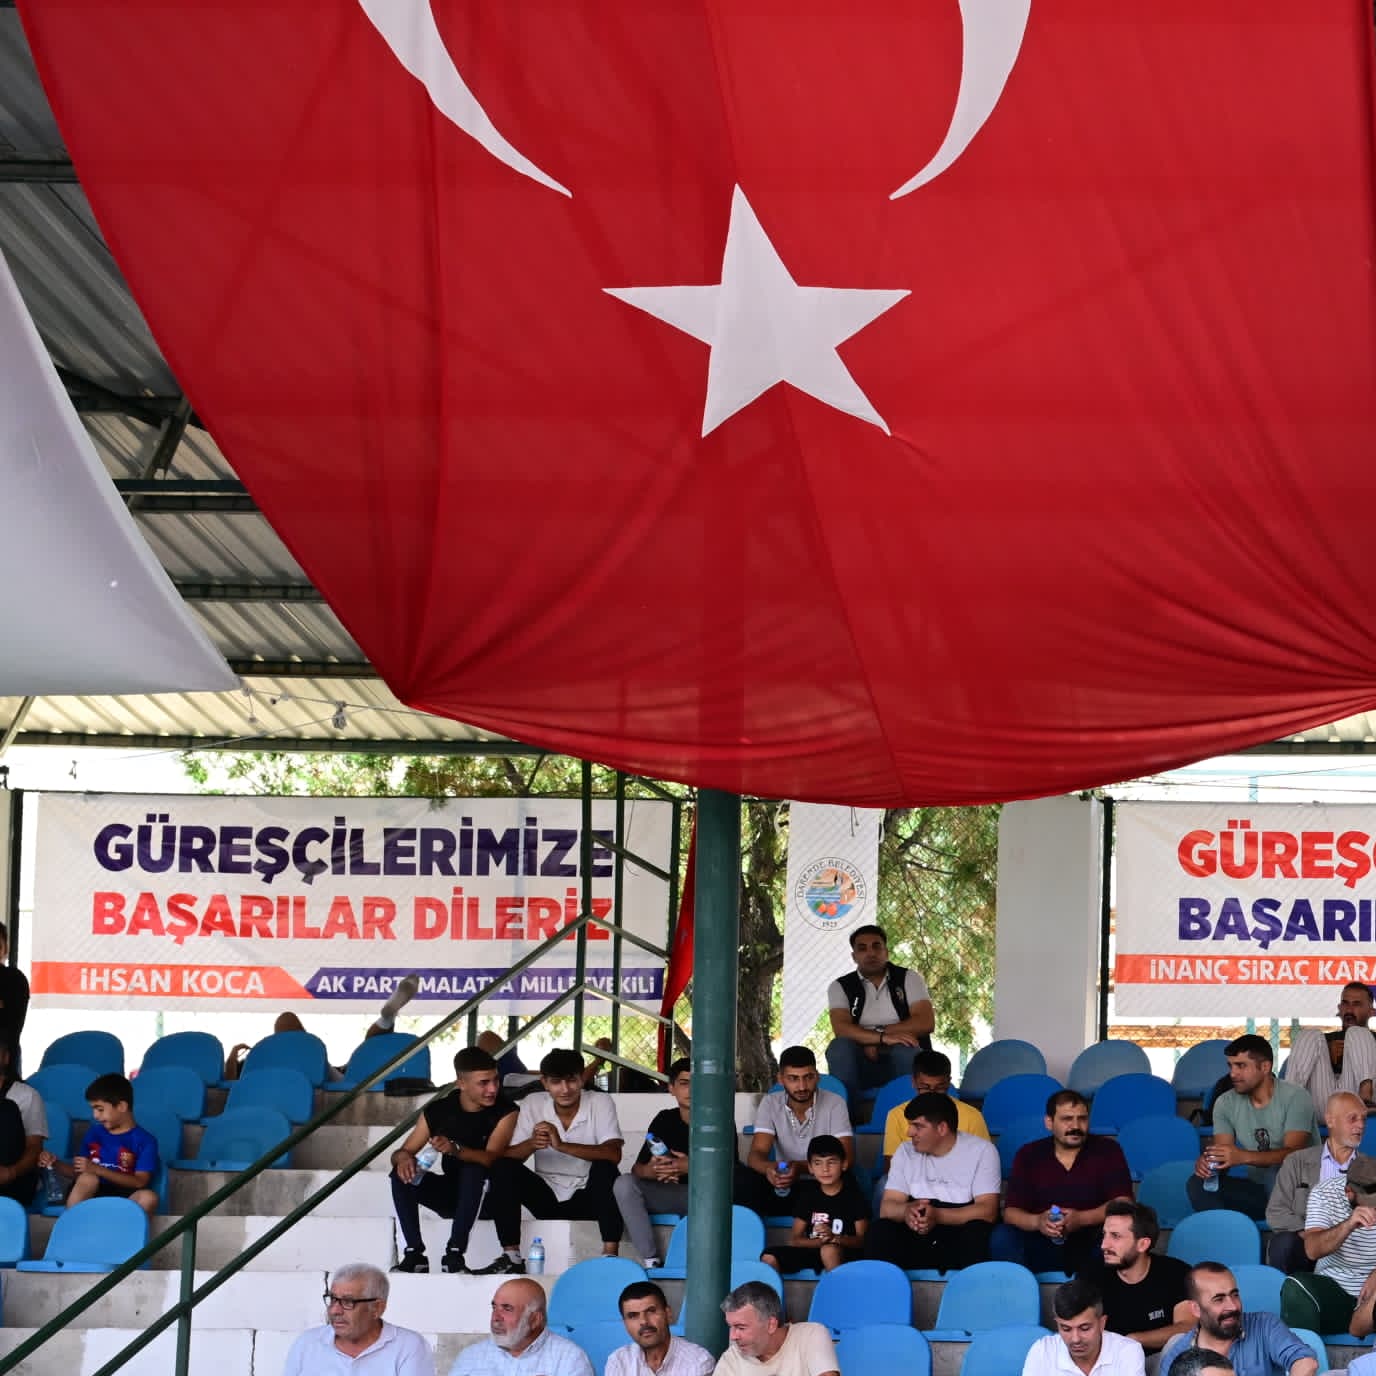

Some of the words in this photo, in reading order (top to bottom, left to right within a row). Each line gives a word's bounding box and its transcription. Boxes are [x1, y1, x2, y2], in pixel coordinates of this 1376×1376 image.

[94, 813, 614, 884] GÜREŞÇİLERİMİZE
[92, 891, 397, 945] BAŞARILAR
[413, 886, 613, 941] DİLERİZ
[182, 969, 265, 995] KOCA
[316, 975, 346, 993] AK
